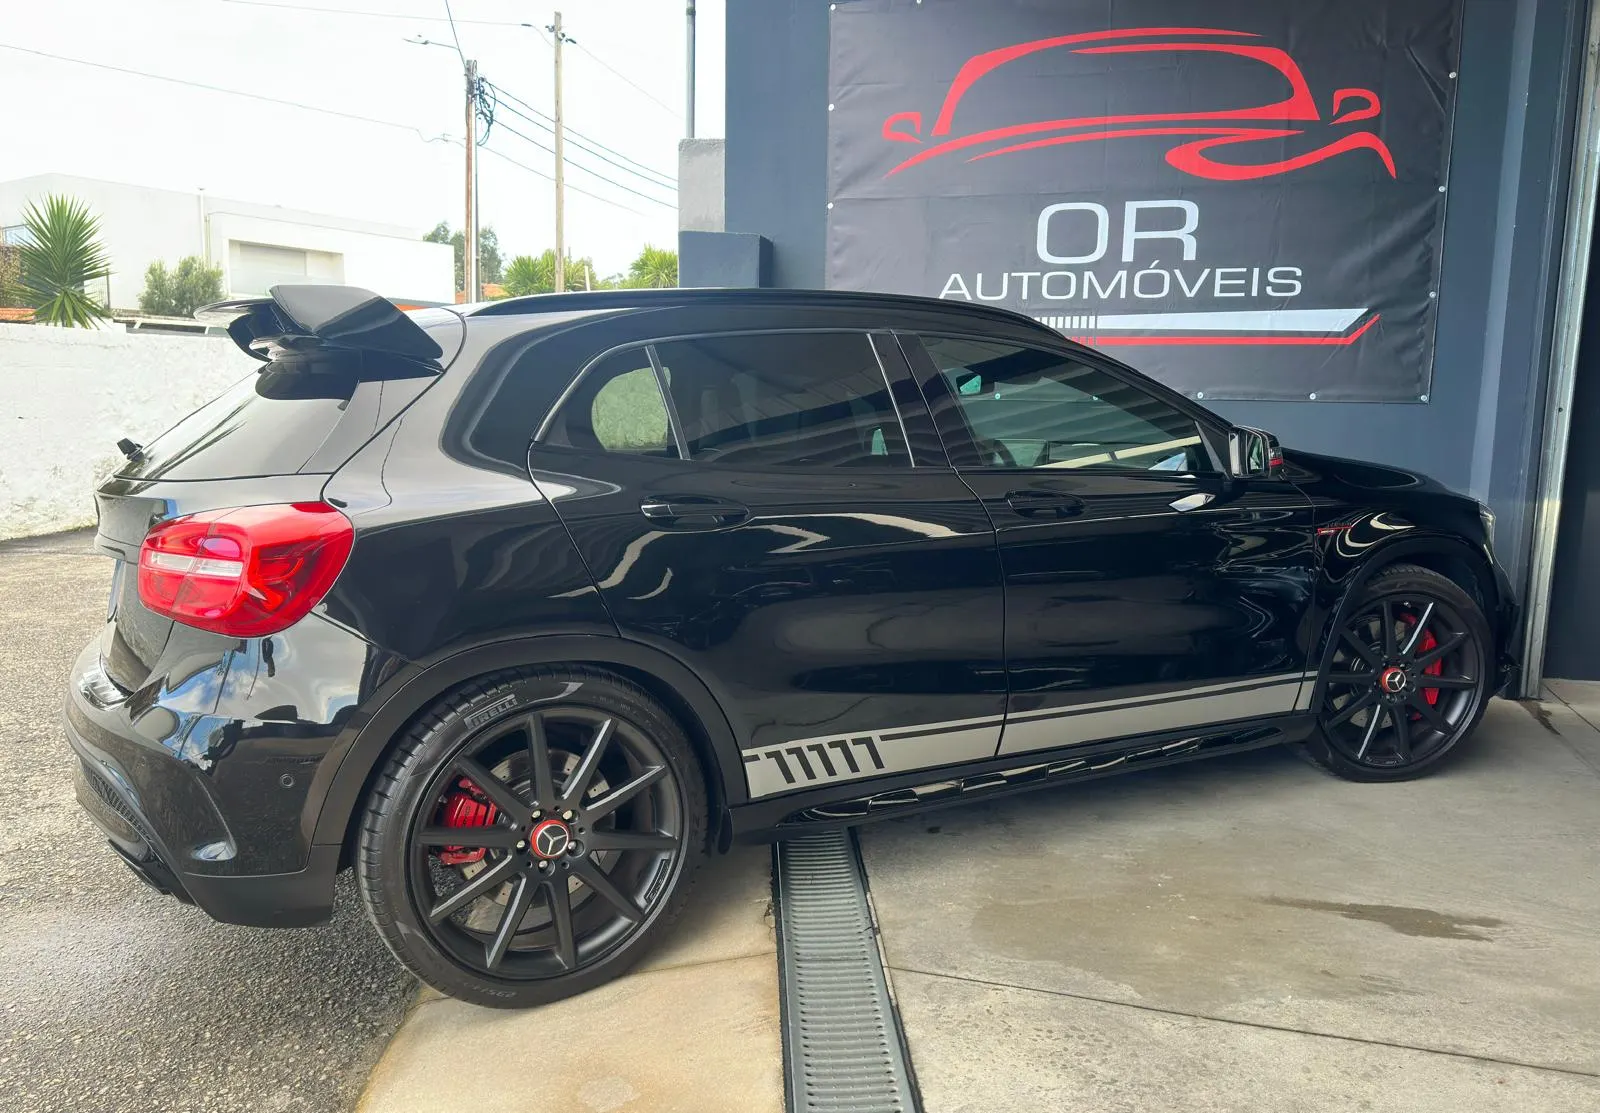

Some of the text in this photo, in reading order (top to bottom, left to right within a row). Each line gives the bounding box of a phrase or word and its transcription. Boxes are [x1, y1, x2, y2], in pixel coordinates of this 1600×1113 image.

[1036, 200, 1199, 265] OR
[938, 260, 1302, 301] AUTOMÓVEIS
[463, 694, 518, 730] PIRELLI
